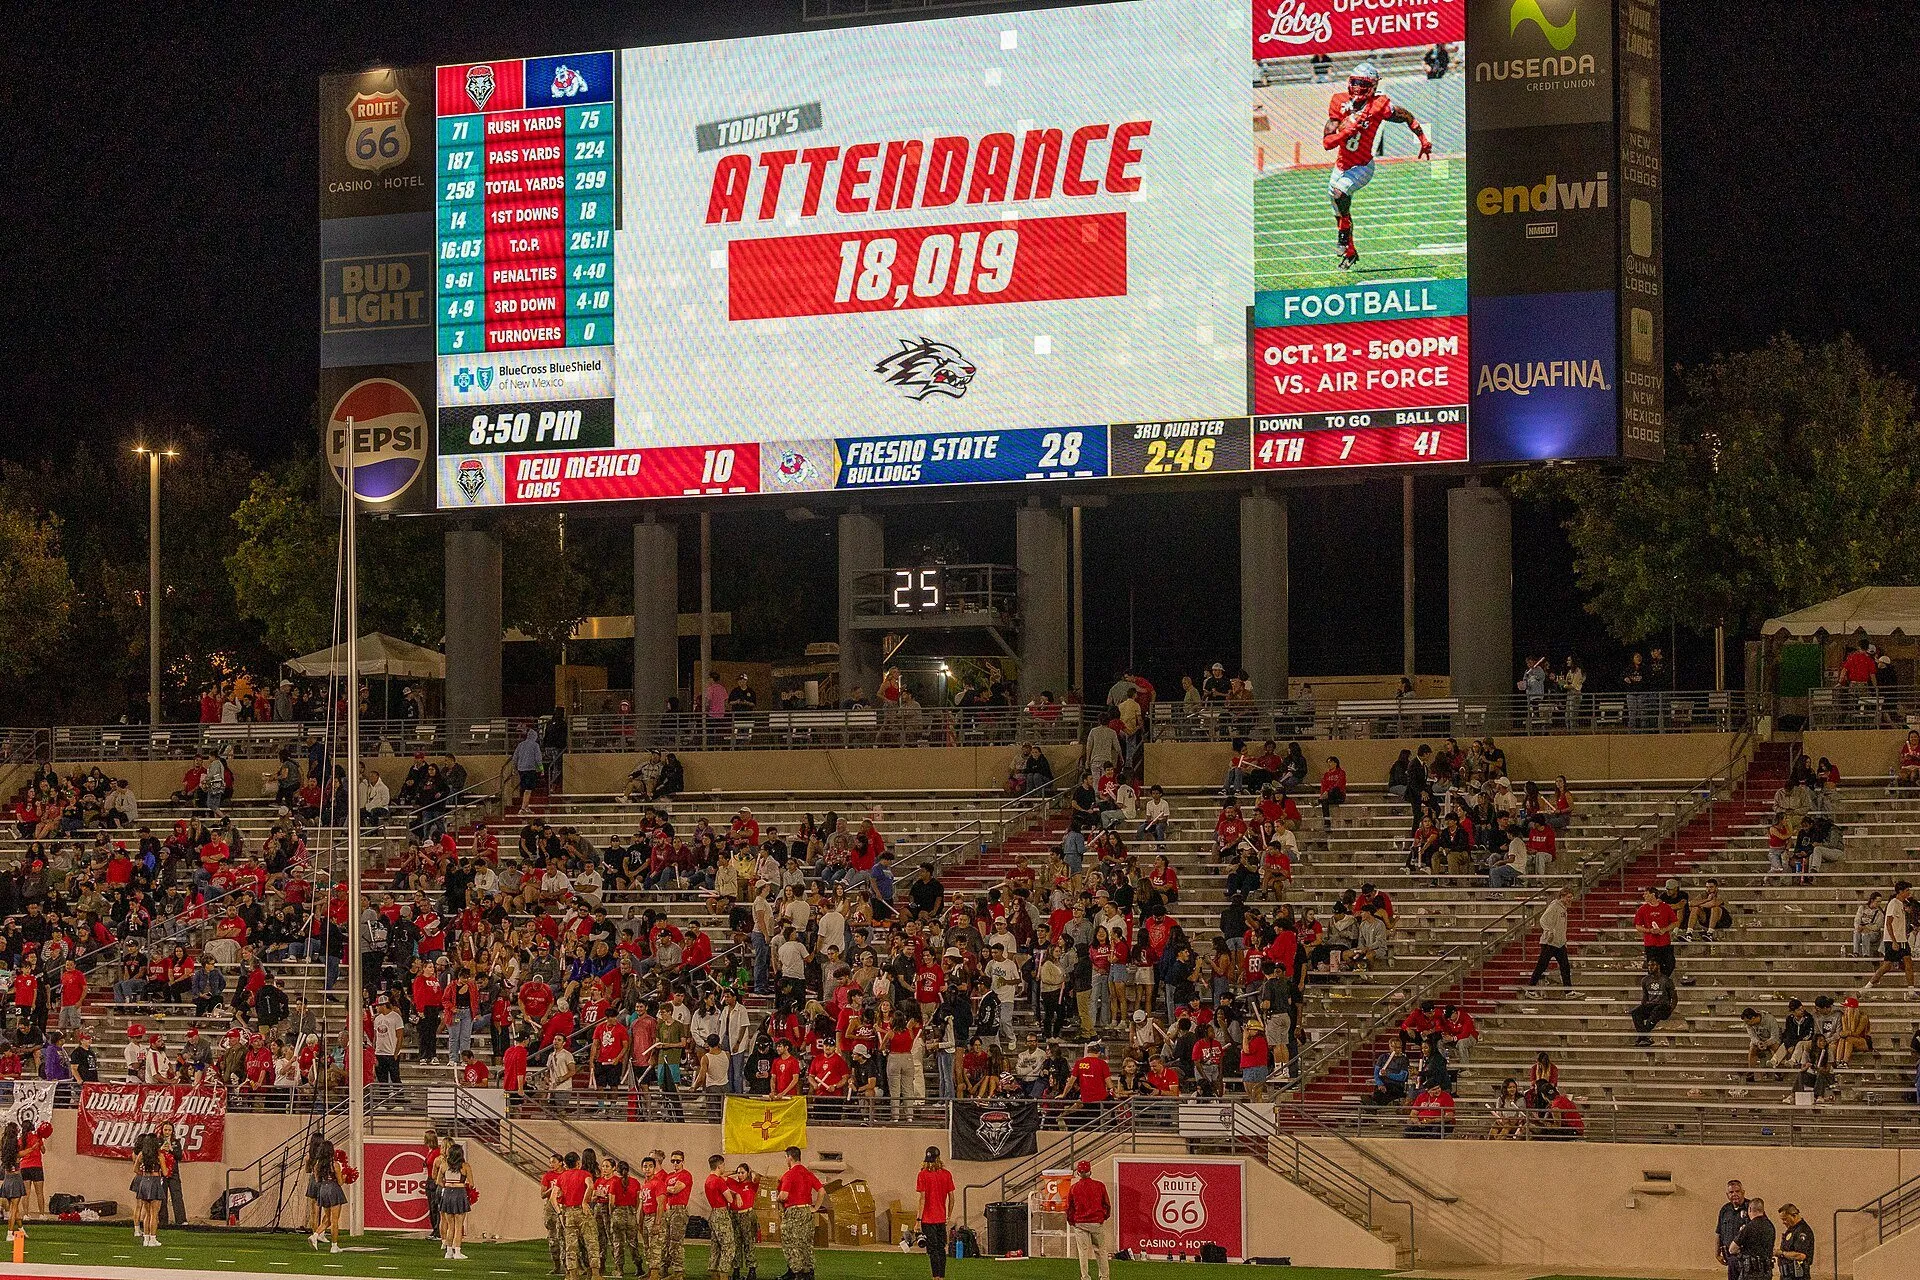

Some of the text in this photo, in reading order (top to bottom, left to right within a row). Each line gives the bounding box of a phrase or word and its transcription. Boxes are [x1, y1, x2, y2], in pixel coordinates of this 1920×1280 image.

[1351, 11, 1439, 36] EVENTS
[1475, 54, 1595, 82] NUSENDA
[1527, 78, 1595, 91] CREDIT UNION
[357, 101, 398, 117] ROUTE
[487, 116, 562, 135] RUSH YARDS
[580, 111, 599, 129] 75
[718, 108, 800, 147] TODAY'S
[452, 122, 469, 140] 71
[355, 125, 400, 160] 66
[574, 141, 605, 160] 224
[447, 152, 473, 170] 187
[489, 147, 560, 165] PASS YARDS
[575, 171, 607, 190] 299
[705, 120, 1153, 224] ATTENDANCE
[1624, 166, 1656, 188] LOBOS
[329, 175, 425, 193] CASINO HOTEL
[445, 181, 476, 201] 258
[485, 176, 564, 195] TOTAL YARDS
[1476, 171, 1608, 215] endwi
[491, 207, 559, 224] 1ST DOWNS
[579, 202, 597, 220] 18
[450, 212, 467, 230] 14
[1528, 226, 1555, 235] NMDOT
[441, 240, 482, 260] 16:03
[510, 238, 540, 252] T.O.P.
[570, 231, 609, 250] 26:11
[493, 267, 557, 284] PENALTIES
[833, 229, 1019, 307] 18,019
[342, 263, 411, 294] BUD
[1625, 276, 1658, 296] LOBOS
[329, 290, 424, 325] LIGHT
[494, 297, 556, 314] 3RD DOWN
[1284, 288, 1437, 319] FOOTBALL
[453, 330, 464, 349] 3
[490, 327, 561, 344] TURNOVERS
[584, 323, 595, 341] 0
[1264, 345, 1318, 365] OCT.
[1323, 343, 1347, 362] 12
[1368, 336, 1458, 360] 5:00PM
[499, 360, 601, 377] BlueCross BlueShield
[1476, 359, 1606, 395] AQUAFINA
[499, 377, 564, 390] of New Mexico
[1274, 366, 1449, 394] VS. AIR FORCE
[1633, 390, 1653, 406] NEW
[1260, 419, 1302, 431] DOWN
[1325, 415, 1370, 428] TO GO
[1396, 410, 1459, 425] BALL ON
[1625, 407, 1661, 426] MEXICO
[469, 410, 582, 446] 8:50 PM
[1134, 421, 1224, 440] 3RD QUARTER
[1627, 425, 1660, 443] LOBOS
[333, 425, 421, 454] PEPSI
[1339, 436, 1355, 459] 7
[1413, 431, 1440, 456] 41
[846, 436, 999, 466] FRESNO STATE
[1038, 432, 1083, 468] 28
[1144, 438, 1216, 473] 2:46
[1258, 438, 1304, 463] 4TH
[516, 453, 642, 481] NEW MEXICO
[701, 450, 735, 485] 10
[847, 465, 922, 484] BULLDOGS
[516, 481, 561, 500] LOBOS
[893, 570, 939, 607] 25
[85, 1092, 221, 1115] NORTH END ZONE
[93, 1120, 204, 1151] HOWRS
[385, 1179, 428, 1195] PEPS
[1047, 1181, 1058, 1194] G
[1163, 1181, 1197, 1191] ROUTE
[1162, 1199, 1198, 1224] 66
[1139, 1239, 1176, 1248] CASINO
